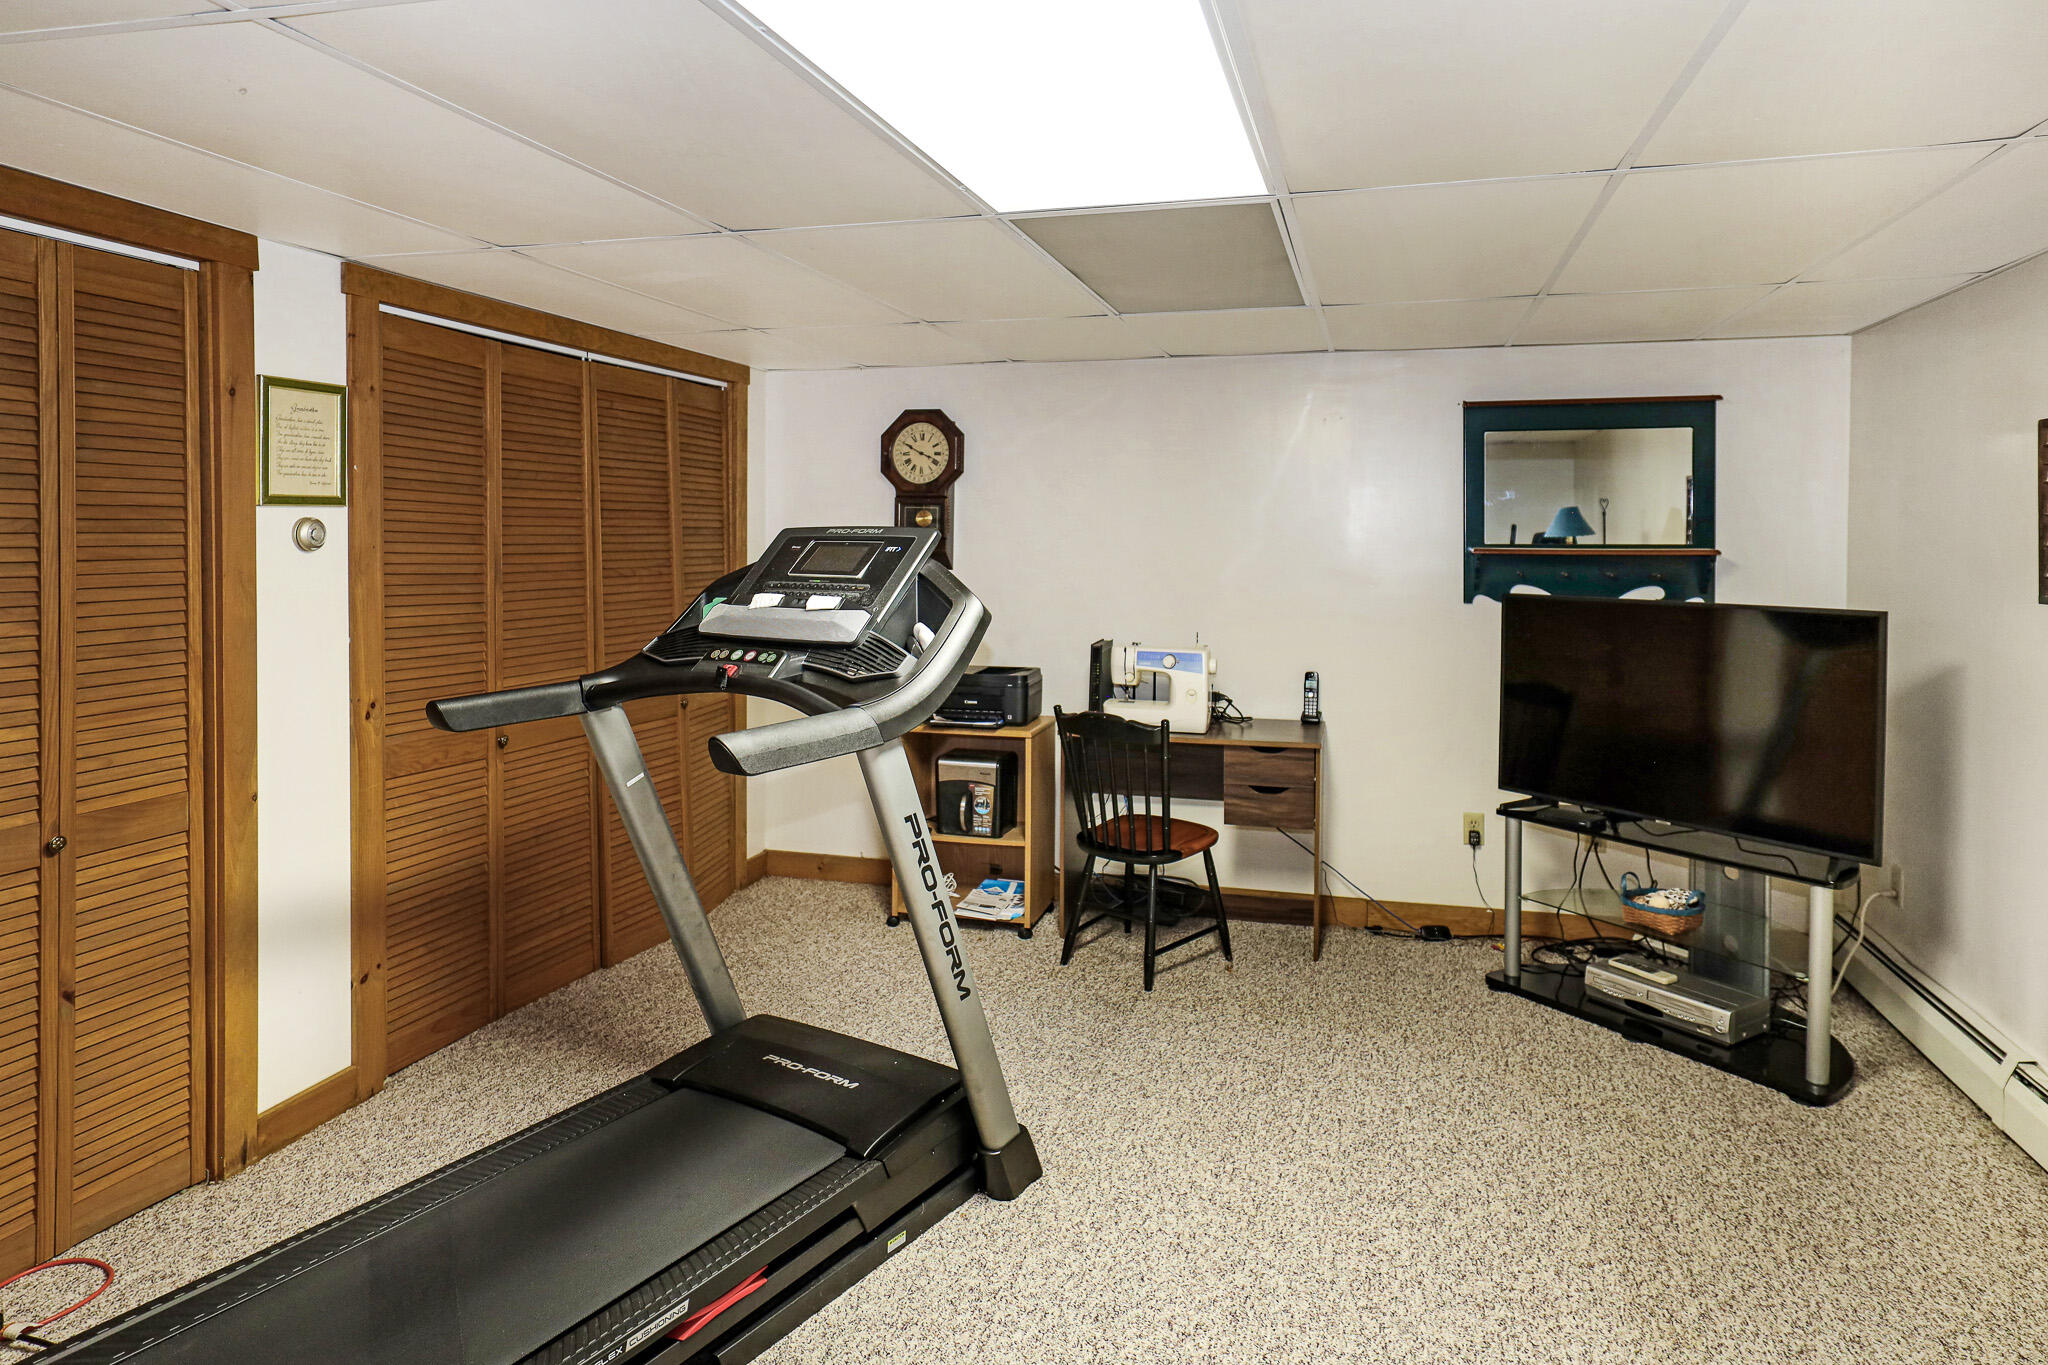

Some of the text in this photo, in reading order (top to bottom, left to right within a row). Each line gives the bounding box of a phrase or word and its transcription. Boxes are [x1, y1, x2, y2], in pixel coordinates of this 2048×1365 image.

[904, 812, 971, 1001] PRO-FORM
[762, 1054, 860, 1089] PRO-FORM
[628, 1304, 686, 1347] CUSHIONING
